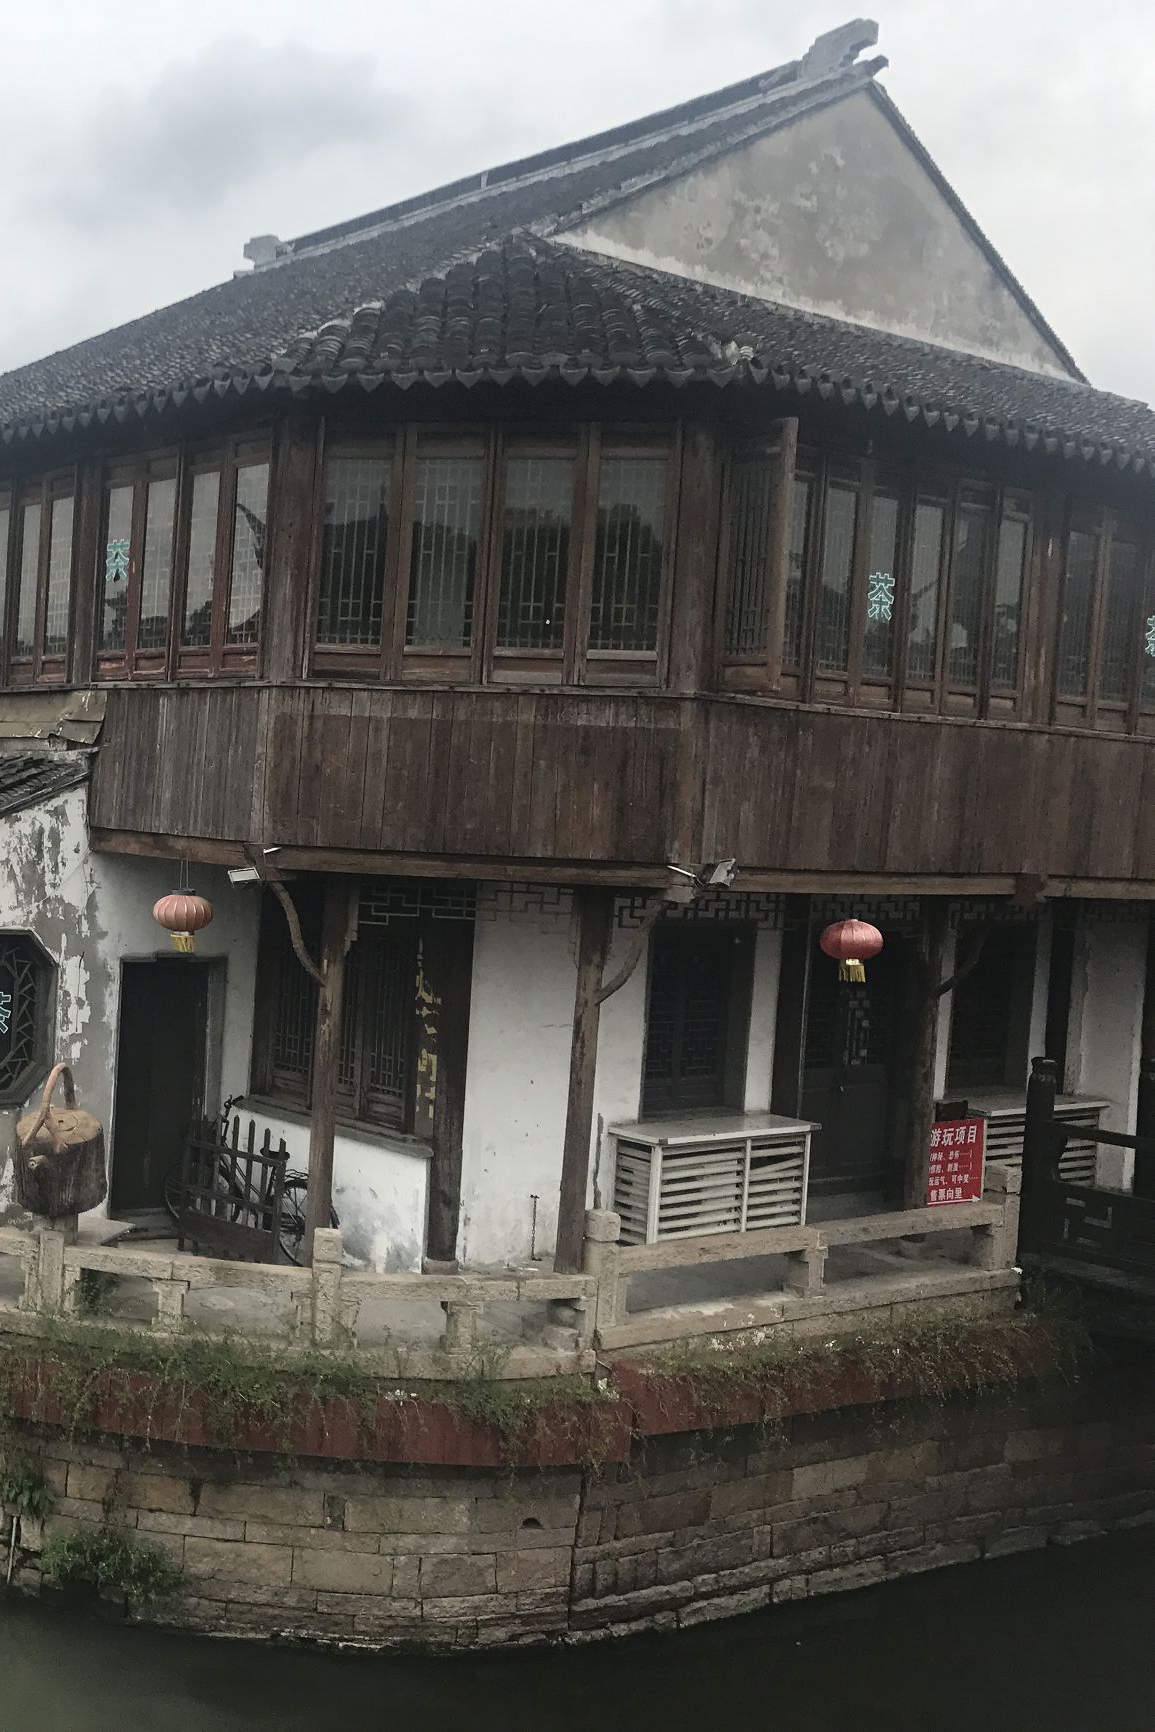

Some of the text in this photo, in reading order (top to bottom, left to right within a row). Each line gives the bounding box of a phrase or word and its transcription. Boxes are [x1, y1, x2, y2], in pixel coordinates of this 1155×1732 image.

[106, 538, 130, 582] 茶
[868, 572, 895, 621] 茶
[930, 1125, 977, 1147] 游玩项目
[930, 1187, 963, 1201] 售票向里
